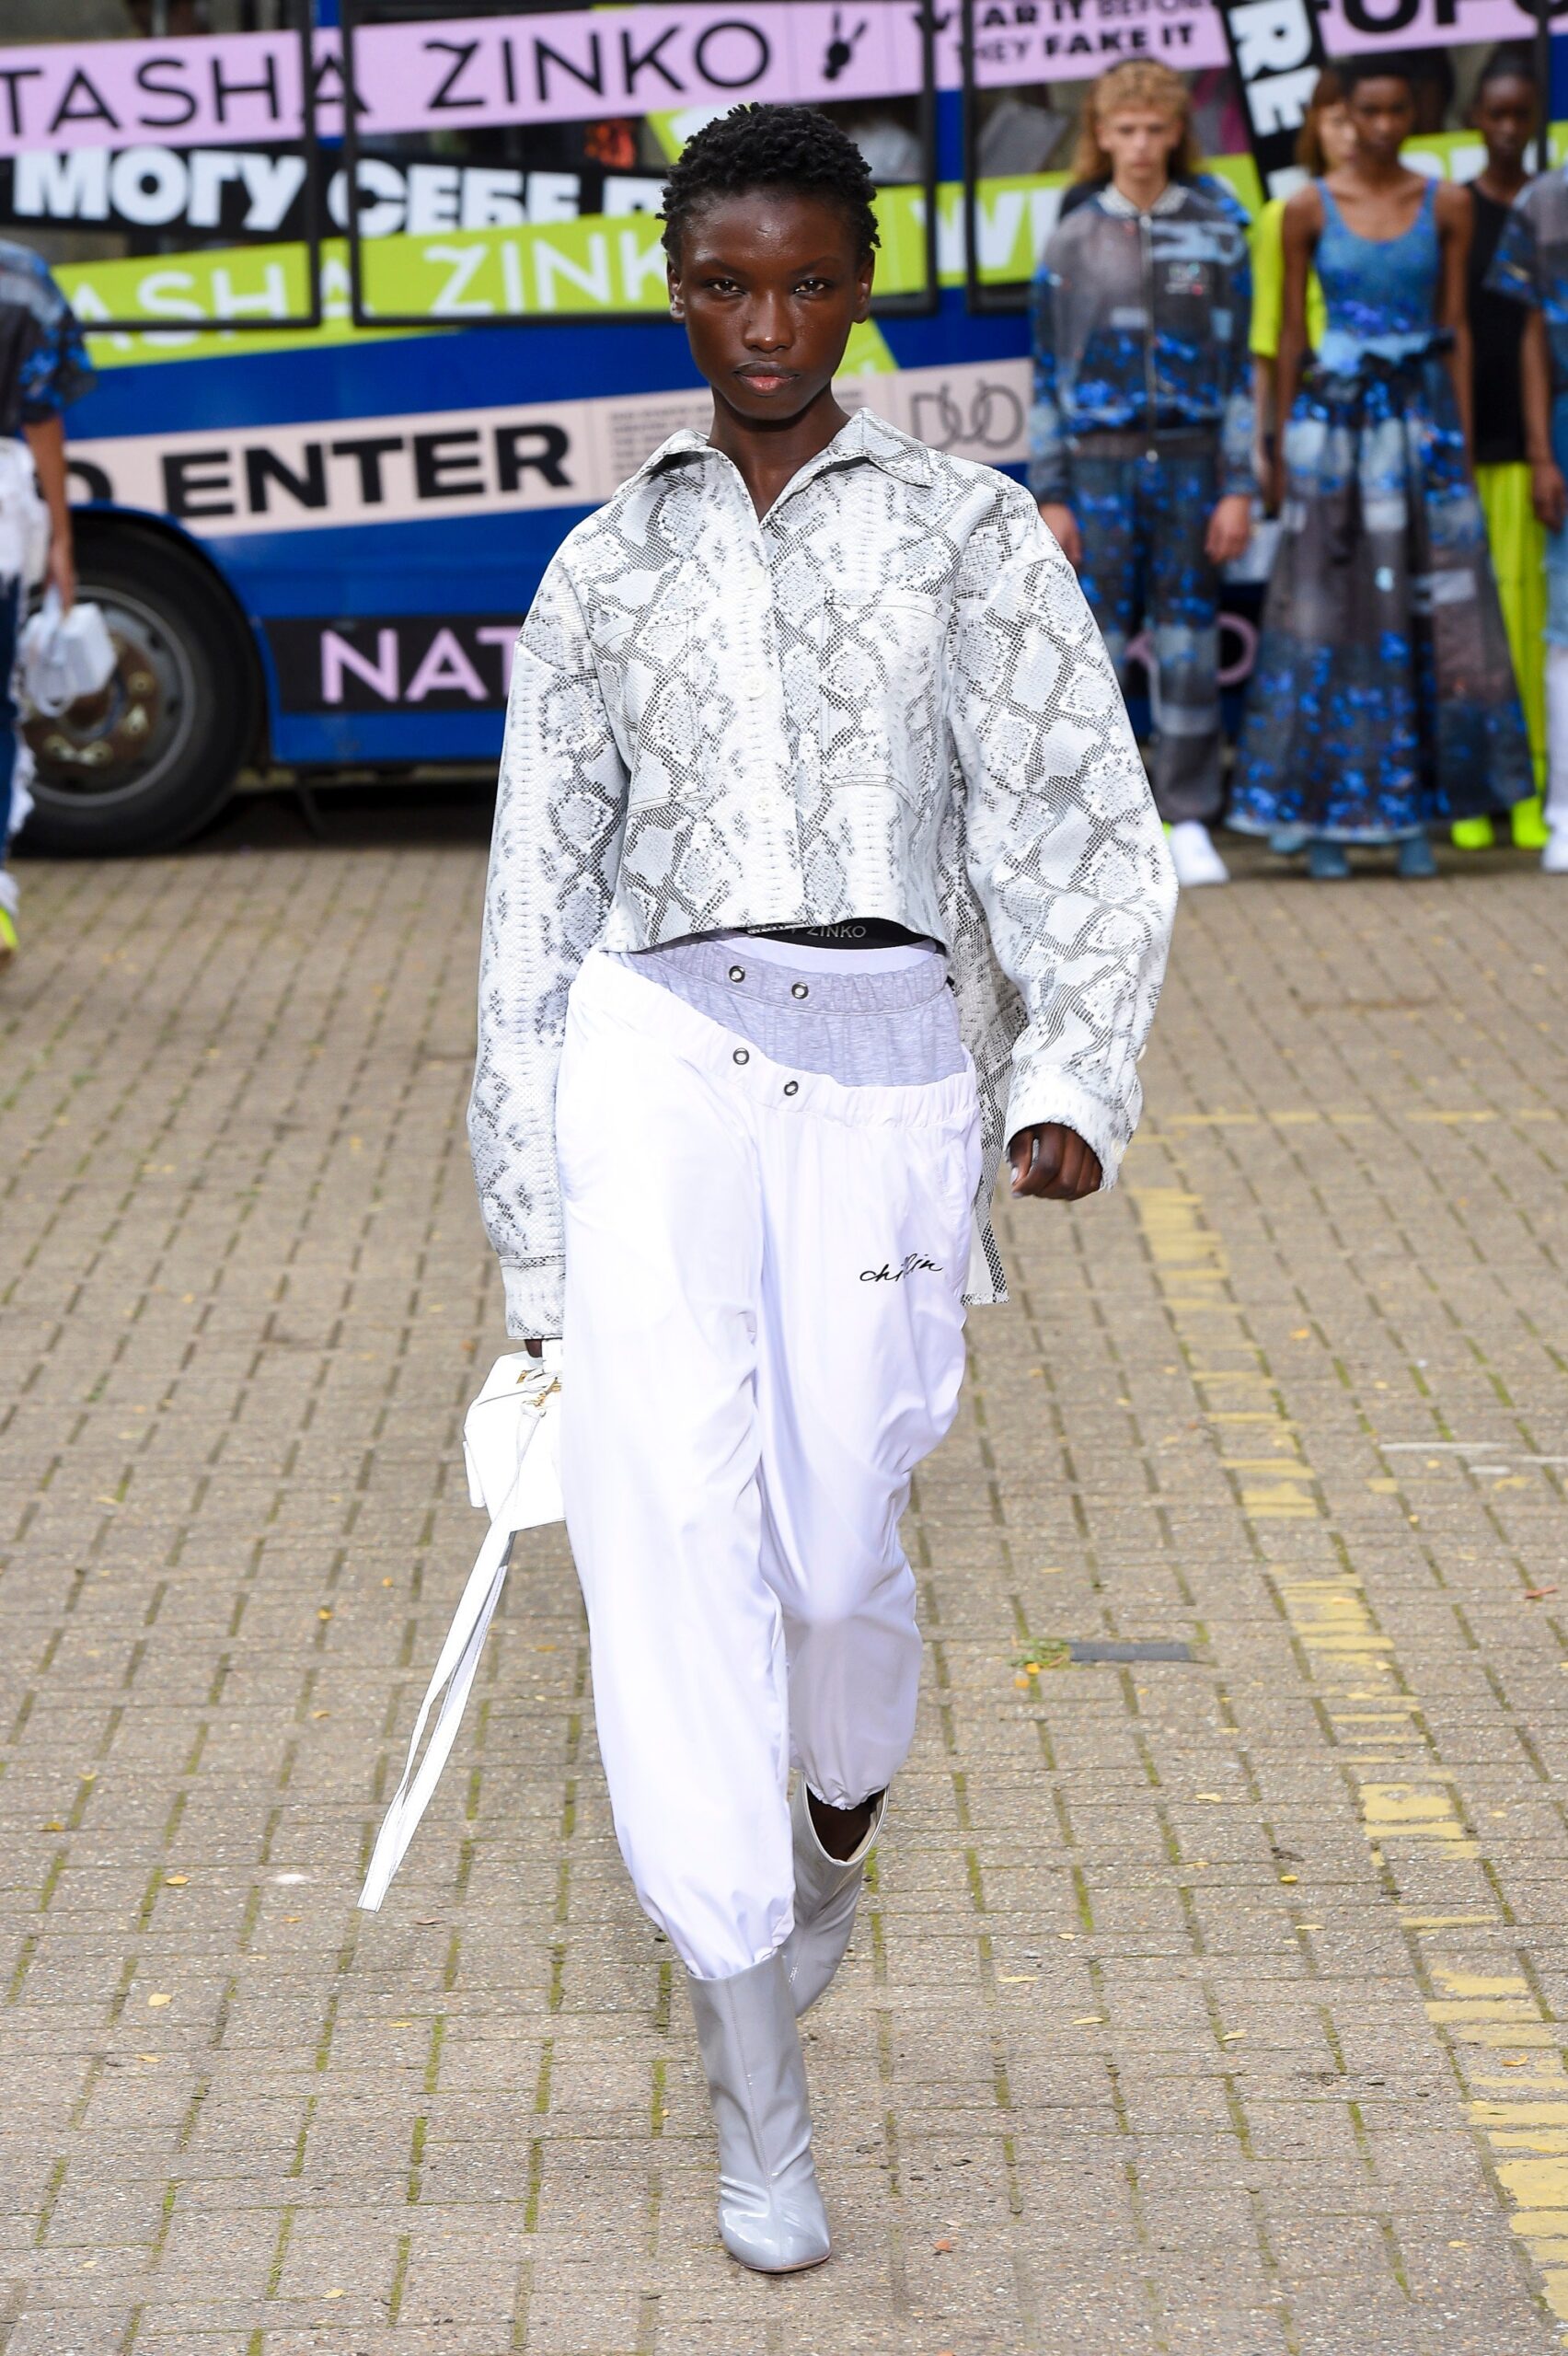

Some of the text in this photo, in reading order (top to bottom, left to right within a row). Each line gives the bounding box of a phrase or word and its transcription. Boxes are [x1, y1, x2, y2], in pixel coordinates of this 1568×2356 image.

[422, 19, 772, 109] ZINKO
[1045, 29, 1148, 58] FAKE
[1163, 25, 1193, 46] IT
[160, 422, 572, 518] ENTER
[806, 924, 867, 939] ZINKO
